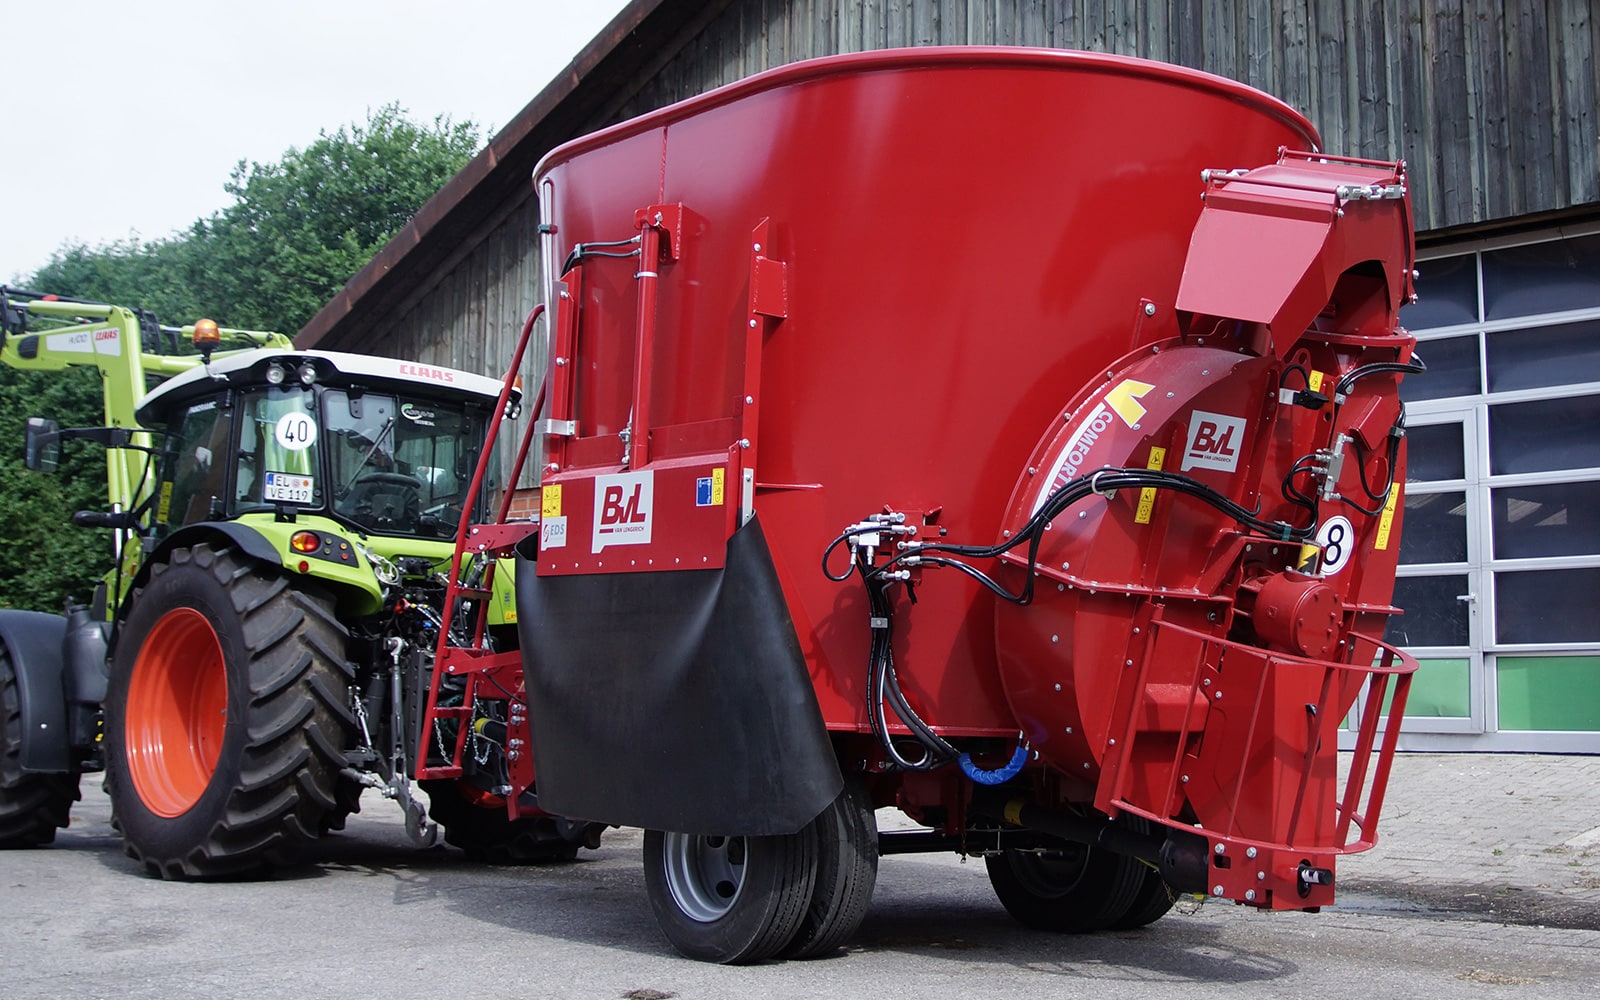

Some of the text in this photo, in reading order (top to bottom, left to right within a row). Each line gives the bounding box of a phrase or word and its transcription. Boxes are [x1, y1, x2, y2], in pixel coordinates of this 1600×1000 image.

[95, 330, 119, 341] CLAAS
[399, 364, 454, 383] CLAAS
[285, 420, 308, 442] 40
[1057, 411, 1113, 484] COMFORT
[275, 475, 290, 488] EL
[270, 487, 308, 501] VE 119
[550, 524, 565, 536] EDS
[1324, 524, 1345, 565] 8
